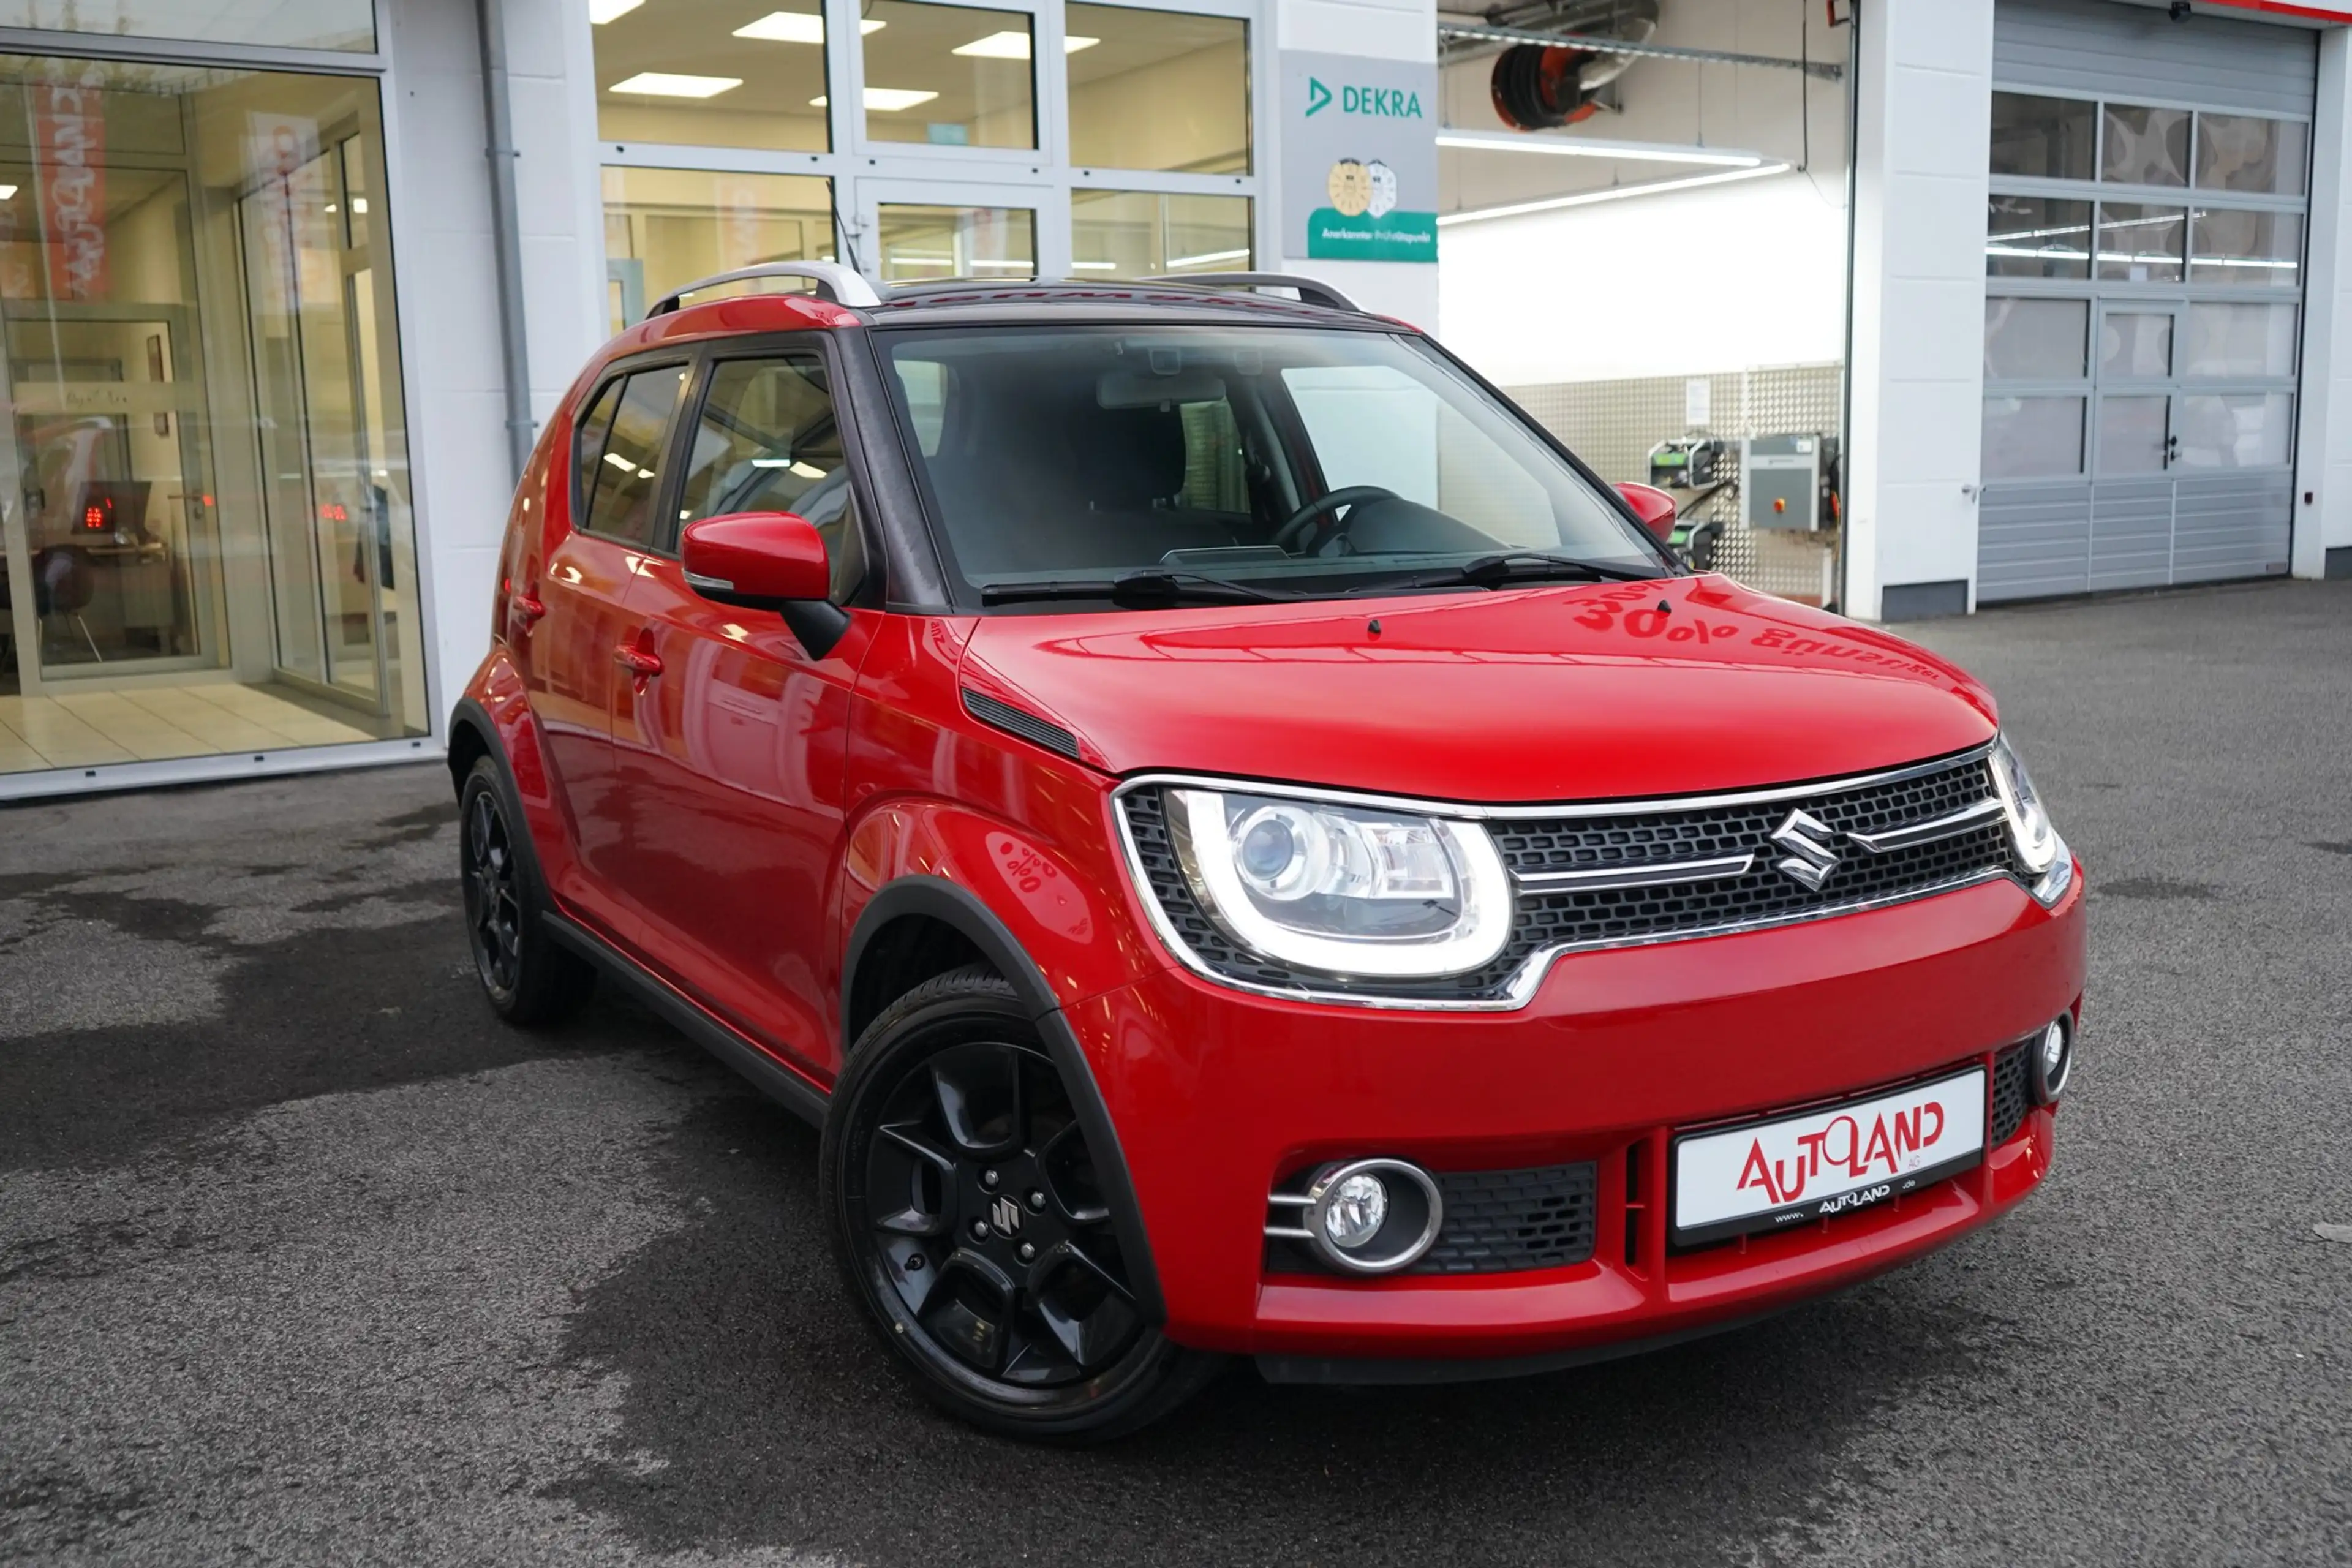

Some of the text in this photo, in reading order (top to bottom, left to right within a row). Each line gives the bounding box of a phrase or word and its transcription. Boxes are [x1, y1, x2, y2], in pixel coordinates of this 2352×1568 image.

[1343, 86, 1422, 118] DEKRA
[1736, 1102, 1945, 1205] AUTOLAND
[1774, 1180, 1916, 1223] www. AUTOLAND .de
